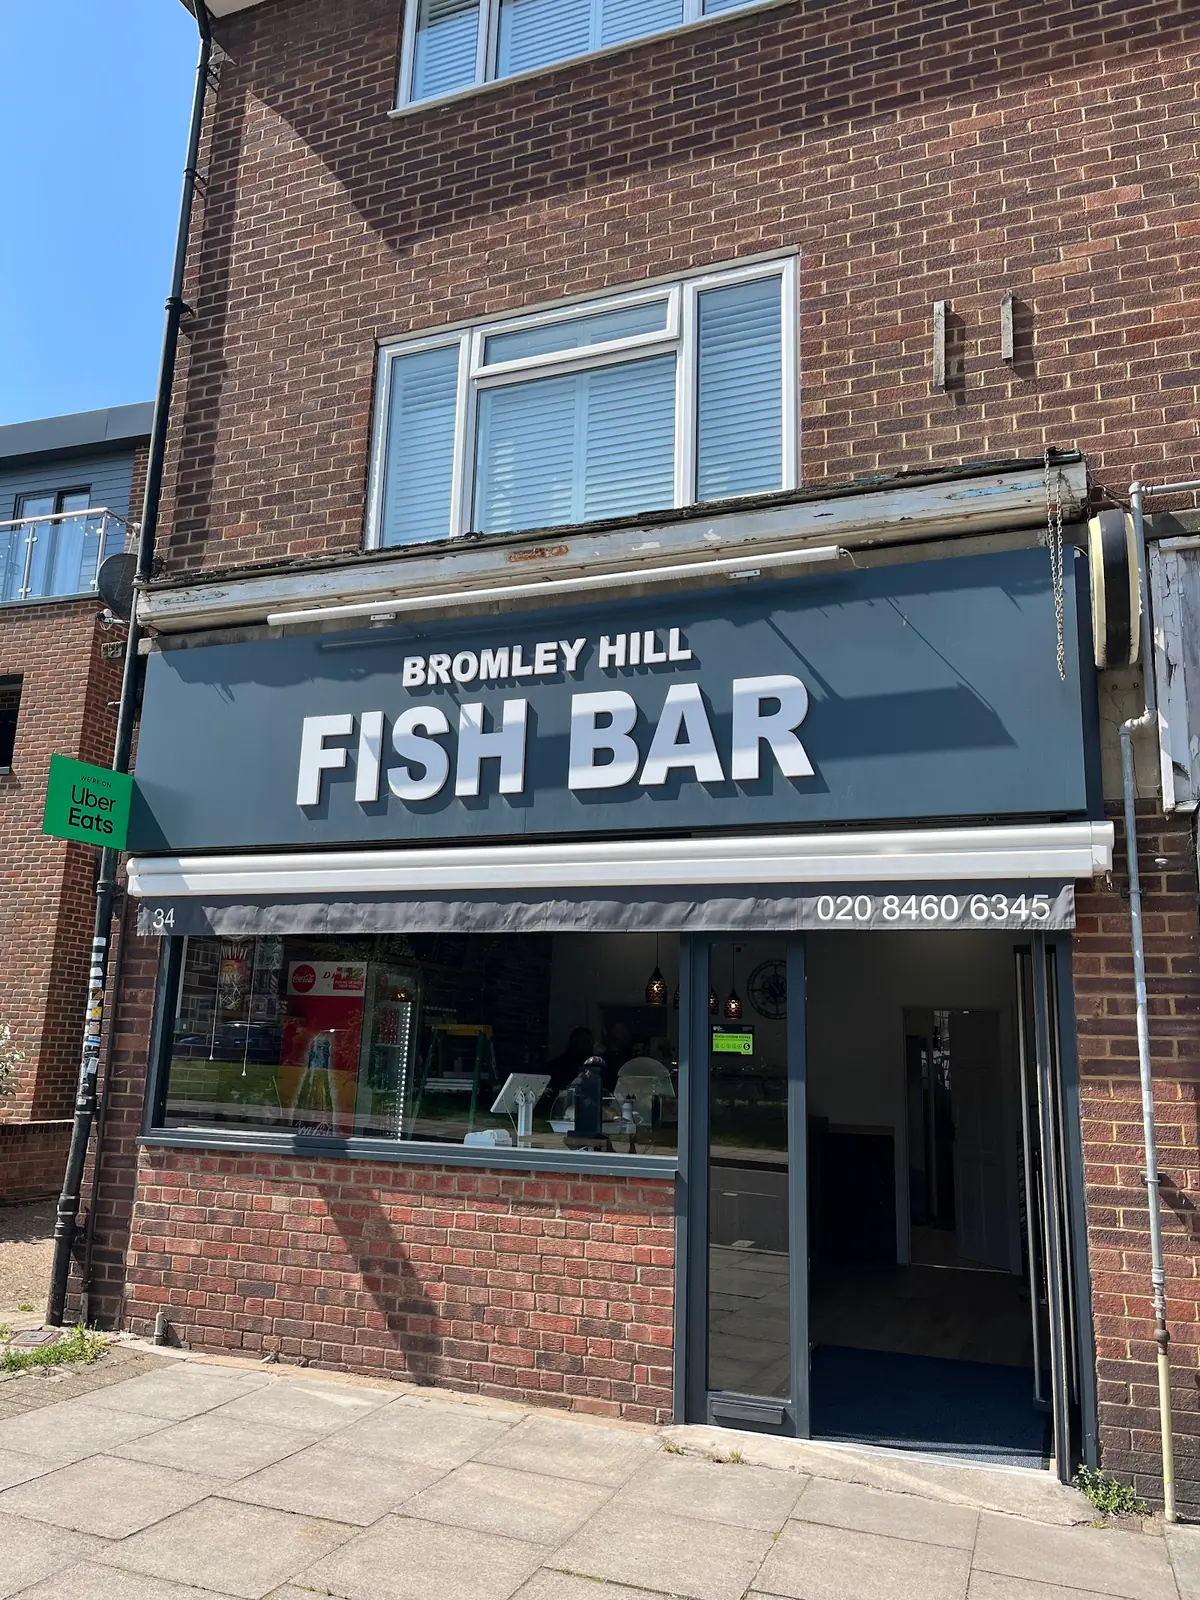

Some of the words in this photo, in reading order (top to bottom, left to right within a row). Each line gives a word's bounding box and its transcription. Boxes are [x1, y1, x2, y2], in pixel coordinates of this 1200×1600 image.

[402, 638, 587, 687] BROMLEY
[599, 628, 692, 668] HILL
[296, 698, 528, 806] FISH
[568, 674, 816, 790] BAR
[71, 784, 116, 812] Uber
[68, 807, 114, 834] Eats
[152, 908, 175, 929] 34
[816, 895, 872, 921] 020
[881, 894, 960, 921] 8460
[969, 893, 1050, 921] 6345
